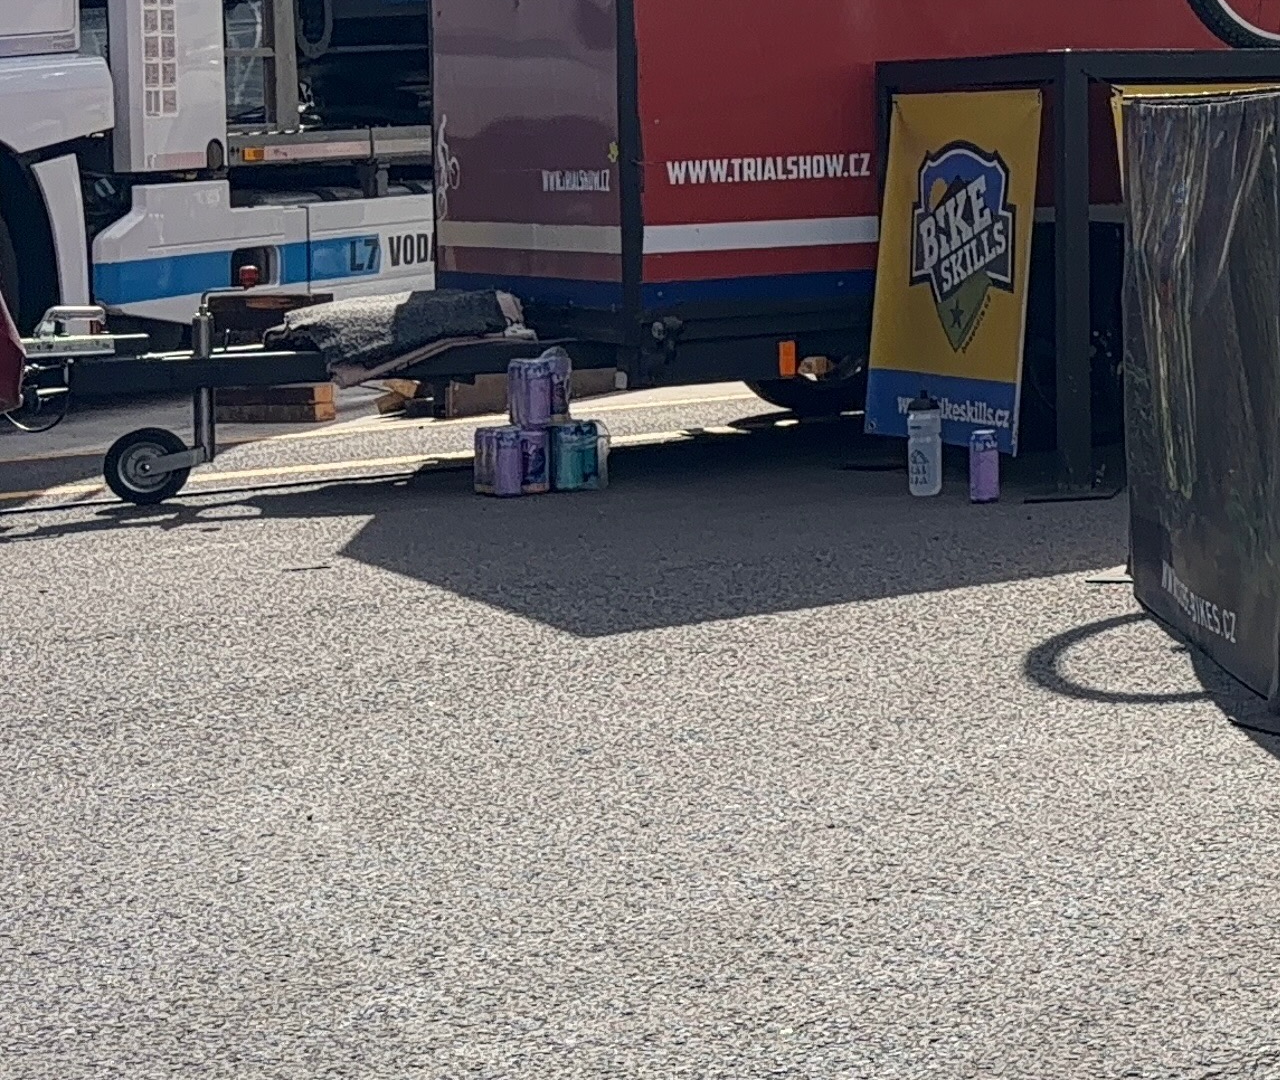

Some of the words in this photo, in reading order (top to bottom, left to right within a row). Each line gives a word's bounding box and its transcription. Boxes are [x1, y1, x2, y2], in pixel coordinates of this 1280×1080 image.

[666, 153, 871, 185] WWW.TRIALSHOW.CZ
[919, 174, 992, 270] BIKE
[940, 220, 1006, 294] SKILLS
